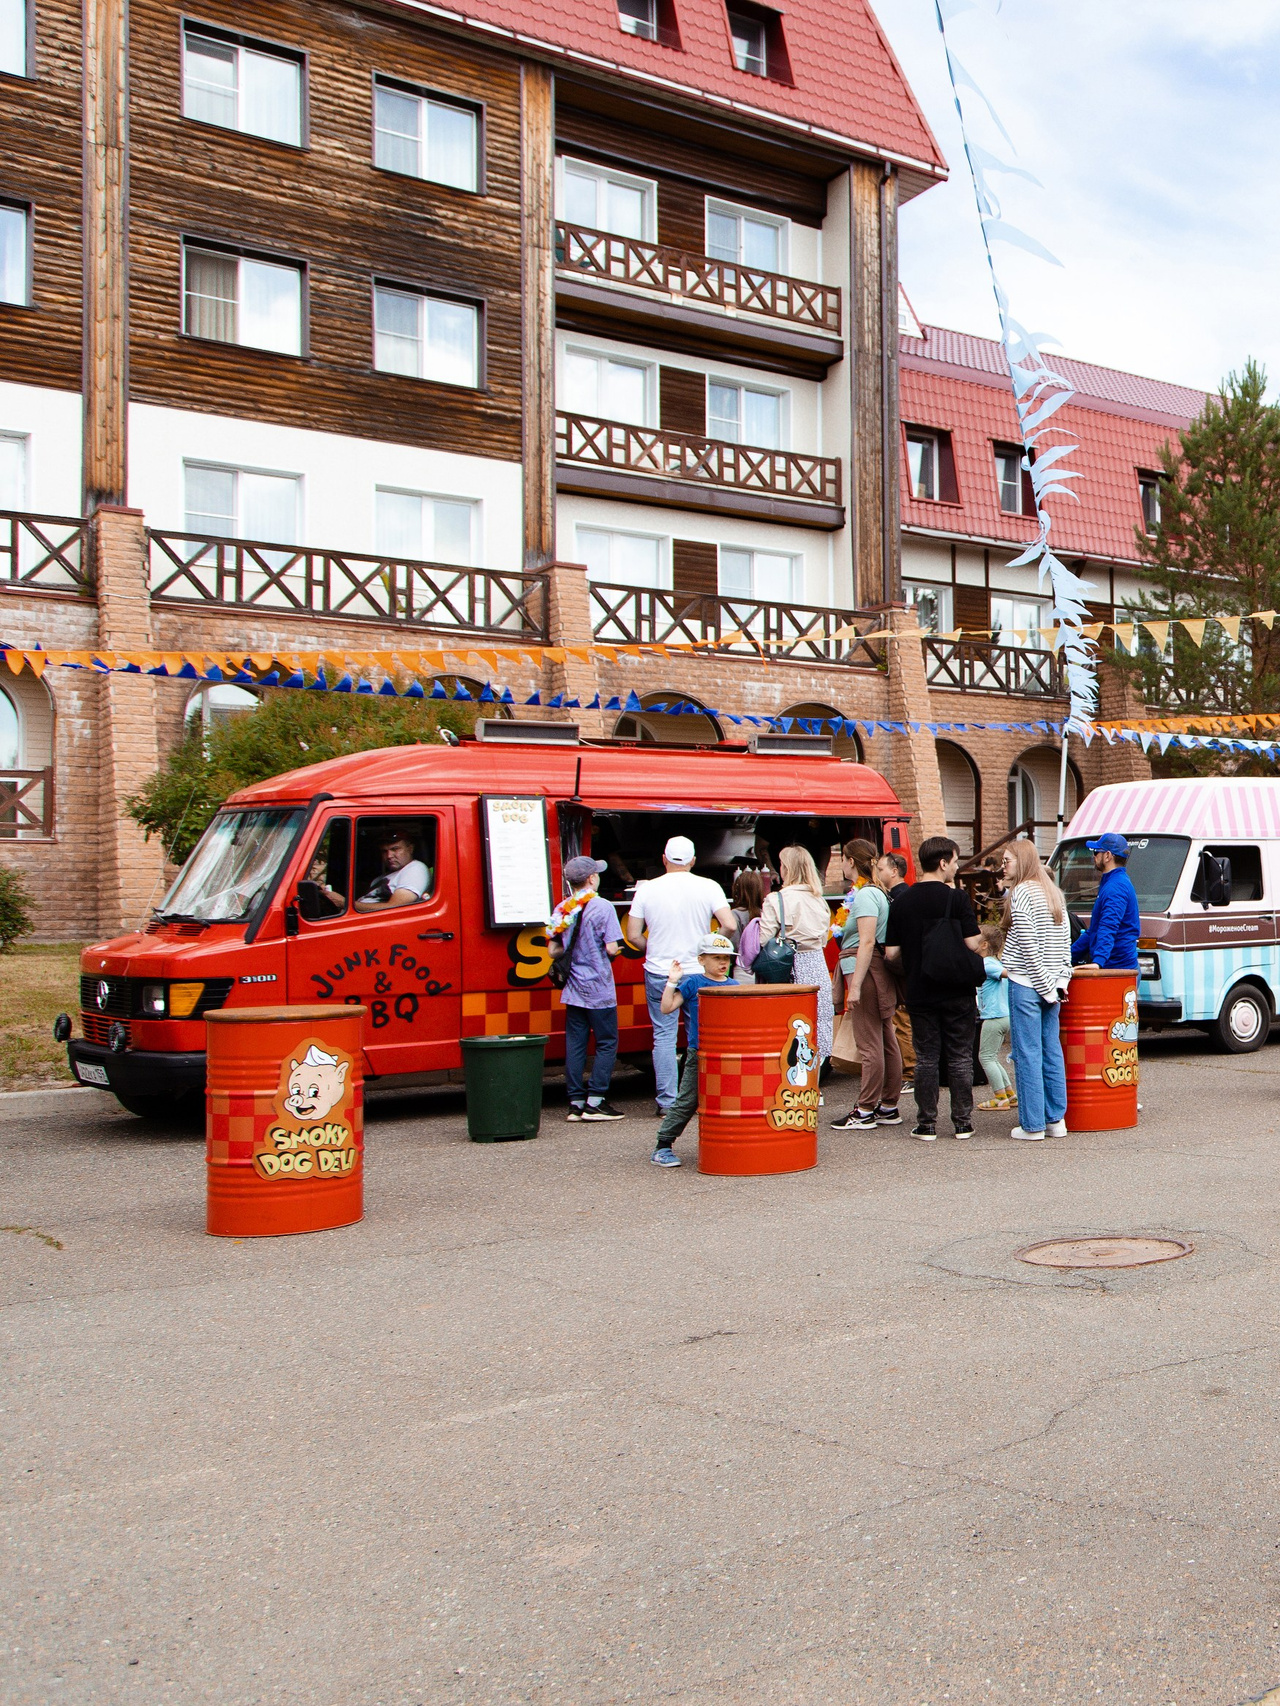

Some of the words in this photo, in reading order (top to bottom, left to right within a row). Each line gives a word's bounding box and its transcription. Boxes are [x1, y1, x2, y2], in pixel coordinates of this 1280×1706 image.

[493, 801, 536, 812] SMOKY
[502, 813, 529, 824] DOG
[374, 971, 392, 994] &
[1105, 1065, 1132, 1083] DOG
[771, 1109, 805, 1127] DOG
[270, 1122, 349, 1150] SMOKY
[256, 1151, 313, 1176] DOG
[316, 1148, 356, 1172] DELI
